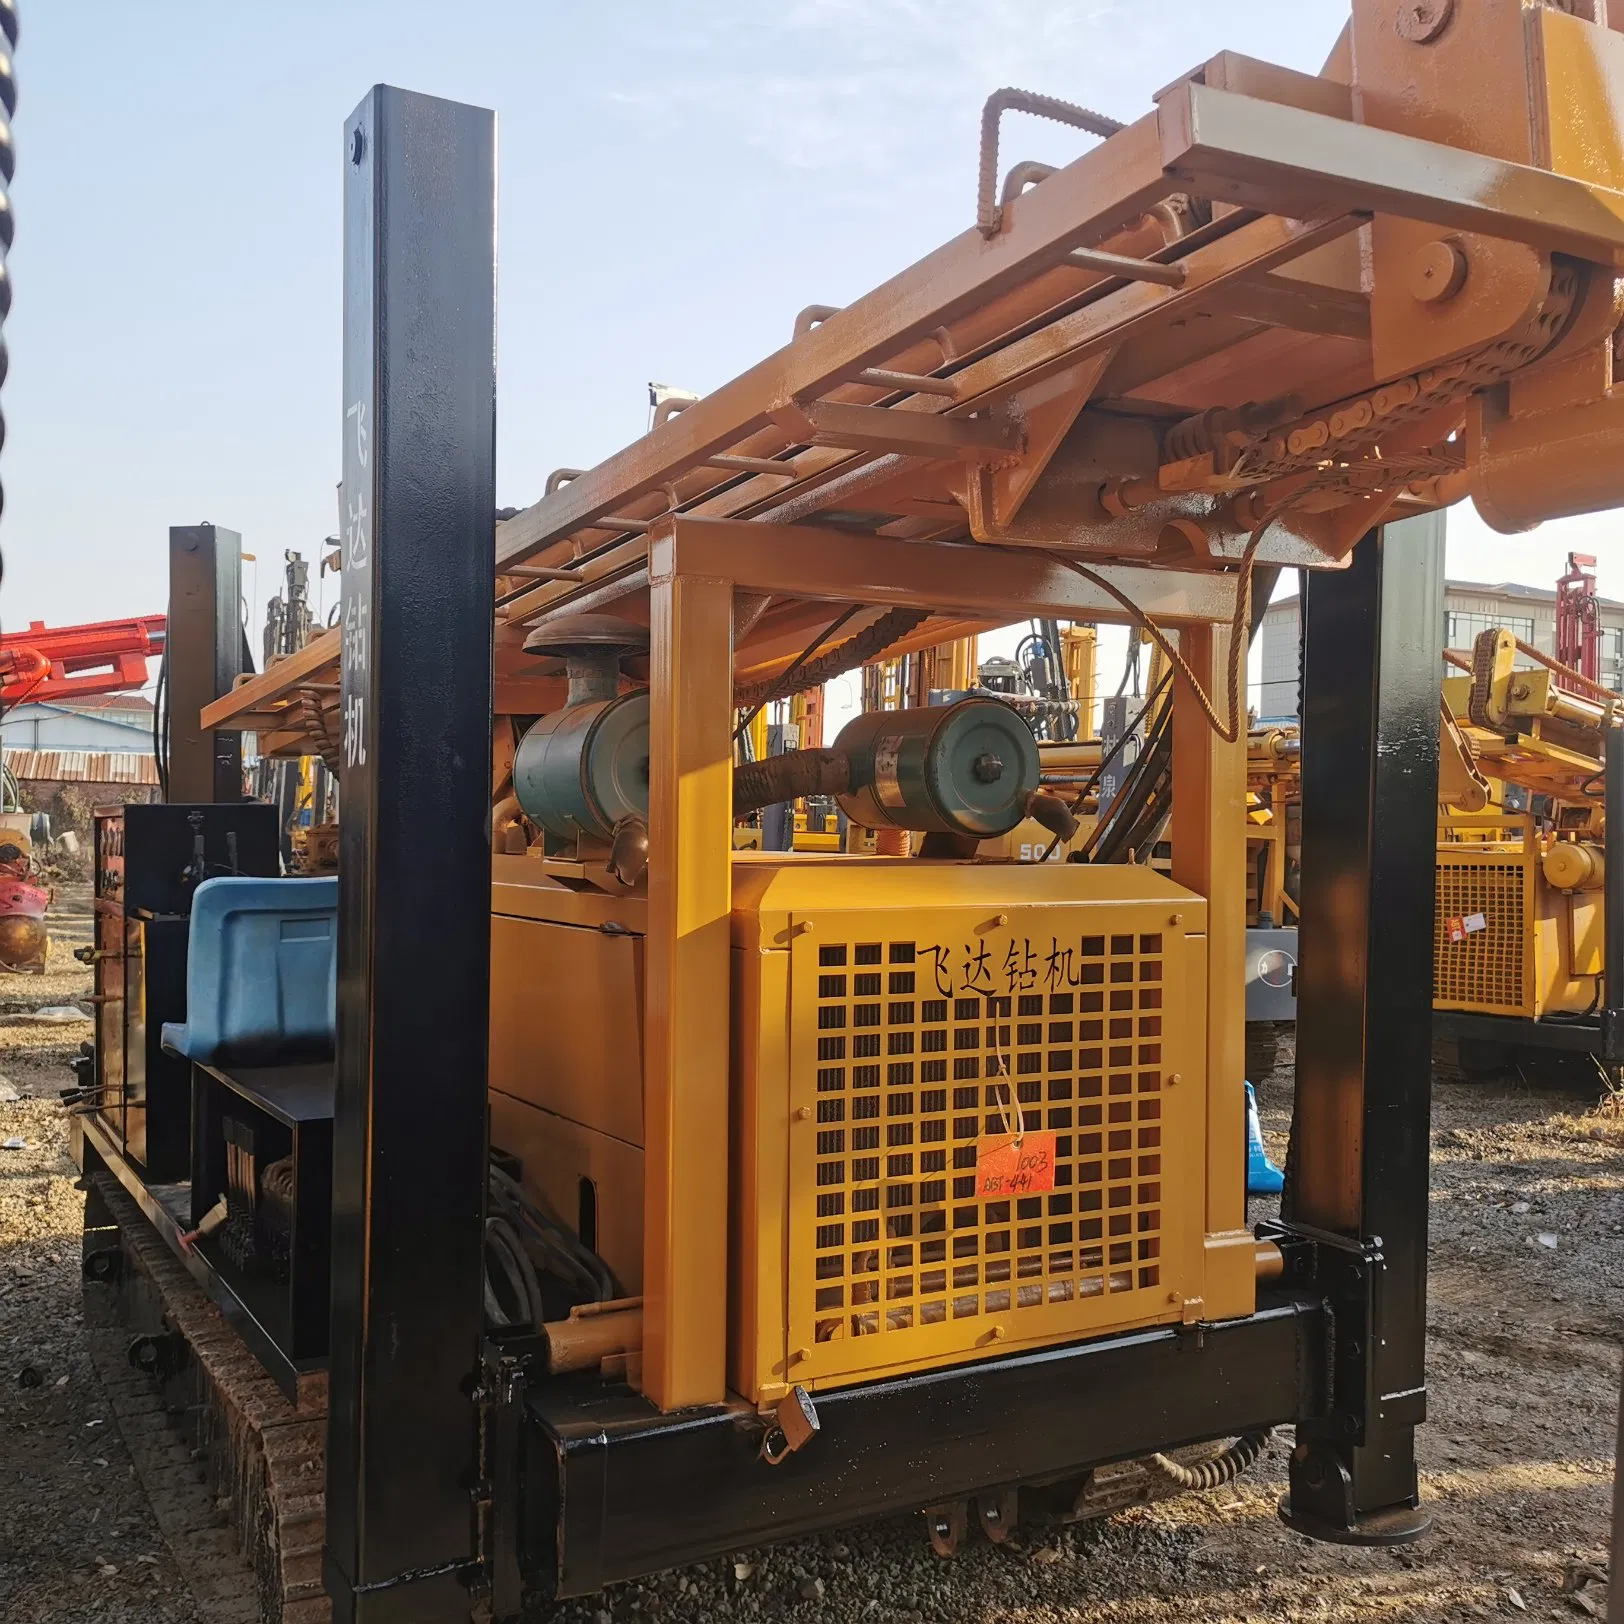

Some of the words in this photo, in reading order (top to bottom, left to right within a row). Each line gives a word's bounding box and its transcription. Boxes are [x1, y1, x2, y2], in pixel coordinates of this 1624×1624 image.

[344, 399, 368, 768] 飞达钻机
[1020, 843, 1061, 860] 500
[917, 936, 1080, 998] 飞达钻机
[1016, 1151, 1049, 1174] 1003
